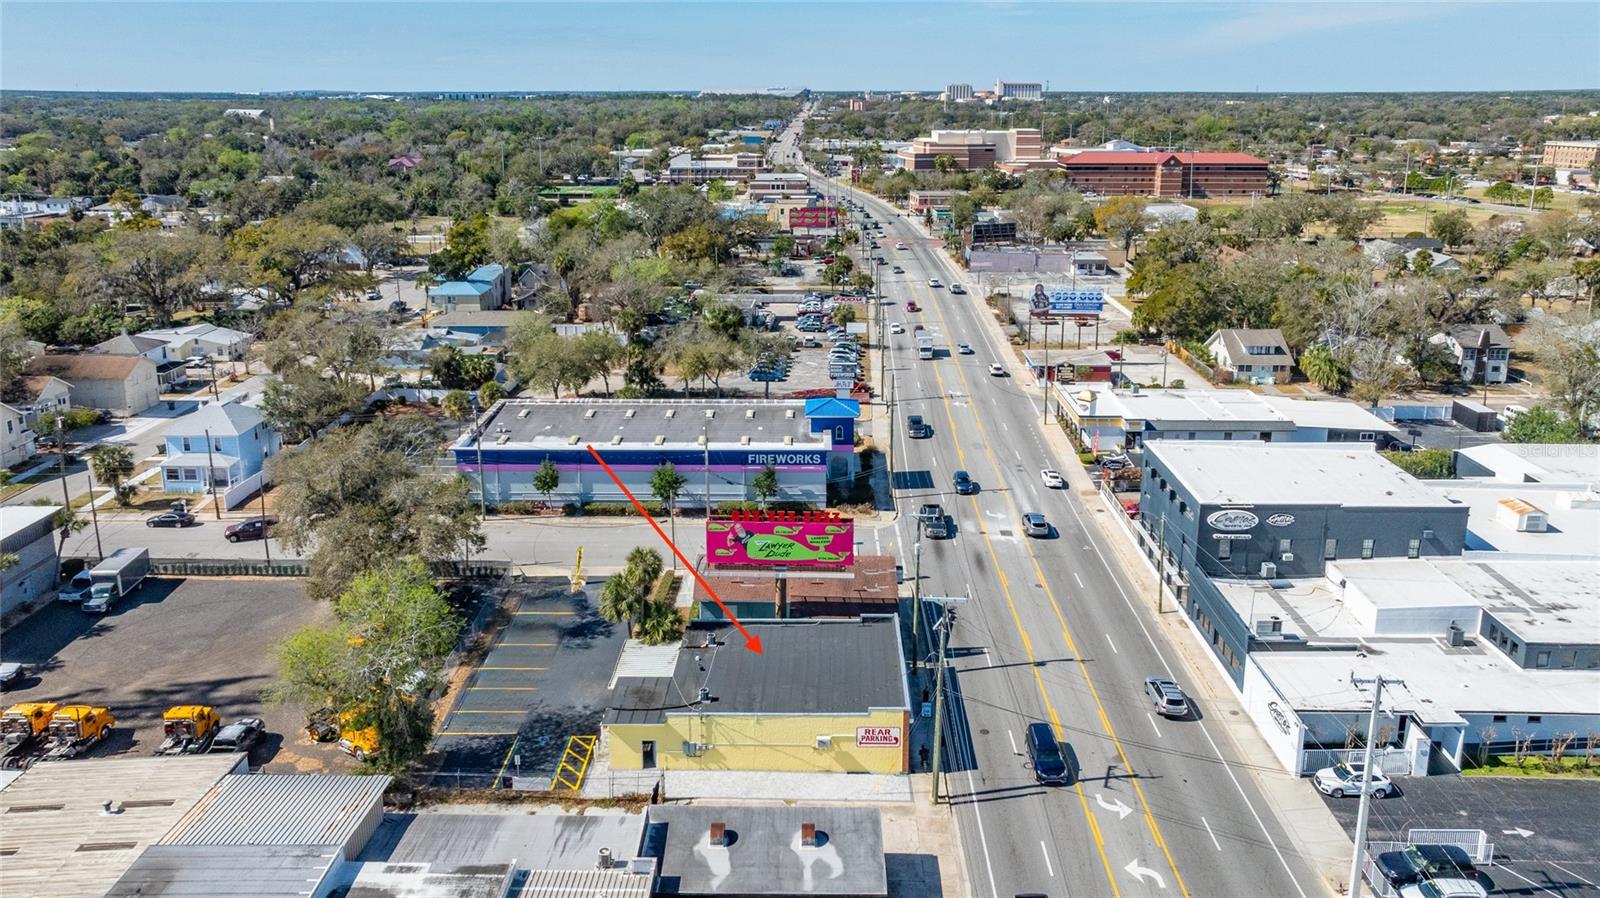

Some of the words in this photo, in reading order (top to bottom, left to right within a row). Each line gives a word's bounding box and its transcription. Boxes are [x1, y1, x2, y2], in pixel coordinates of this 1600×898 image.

[748, 454, 821, 464] FIREWORKS
[764, 550, 792, 558] Dude
[864, 728, 891, 736] REAR
